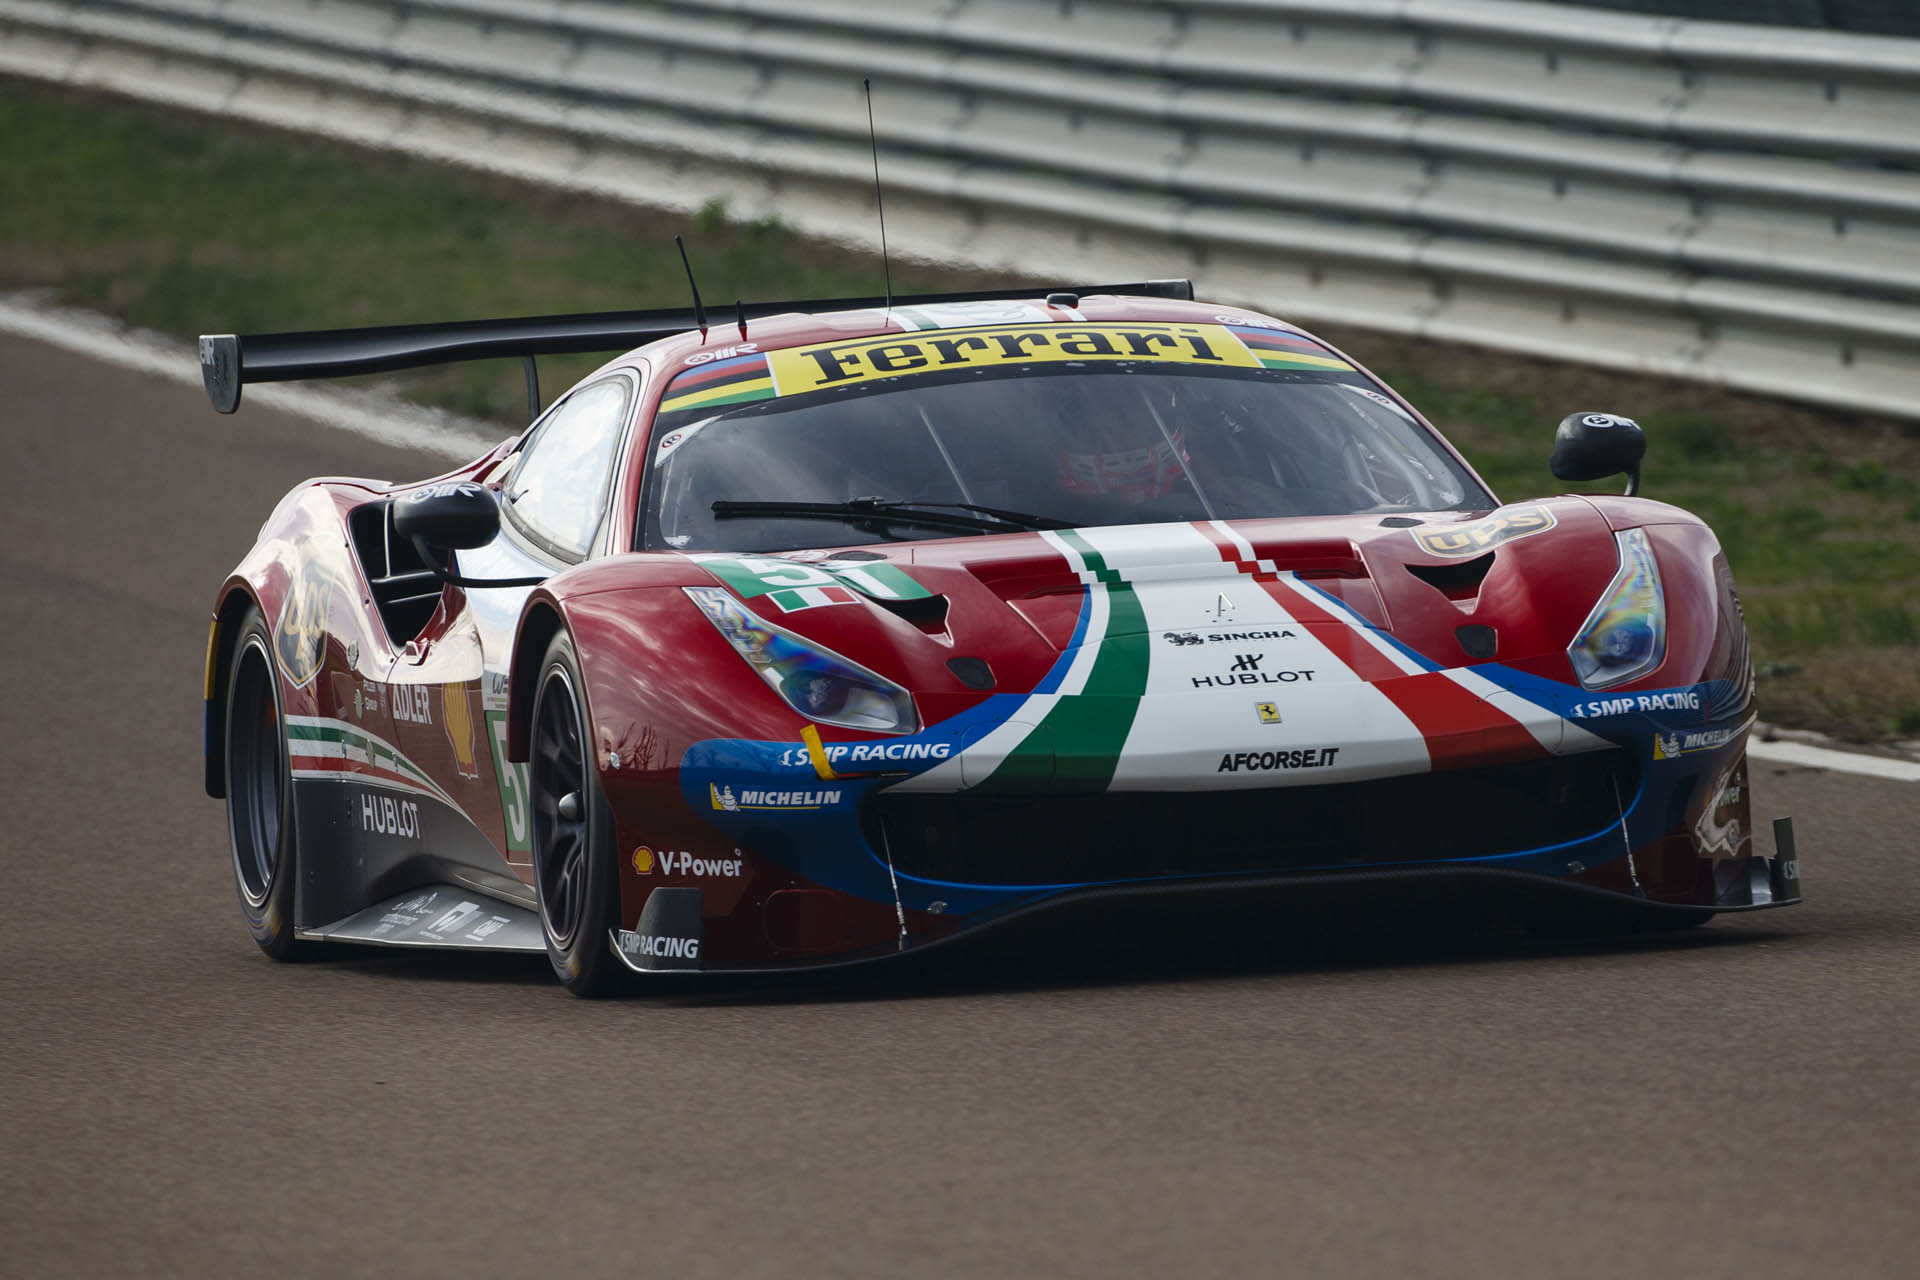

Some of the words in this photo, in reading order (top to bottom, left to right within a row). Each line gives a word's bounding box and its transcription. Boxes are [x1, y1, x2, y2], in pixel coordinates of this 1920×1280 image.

[801, 327, 1223, 385] Ferrari
[737, 558, 900, 599] 51
[1208, 630, 1296, 642] SINGHA
[1192, 670, 1315, 688] HUBLOT
[393, 683, 432, 725] ADLER
[1588, 698, 1635, 718] SMP
[1637, 692, 1699, 712] RACING
[850, 743, 950, 762] RACING
[1218, 747, 1339, 773] AFCORSE.IT
[741, 790, 842, 805] MICHELIN
[361, 793, 420, 840] HUBLOT
[658, 850, 742, 877] V-Power
[640, 935, 699, 959] RACING
